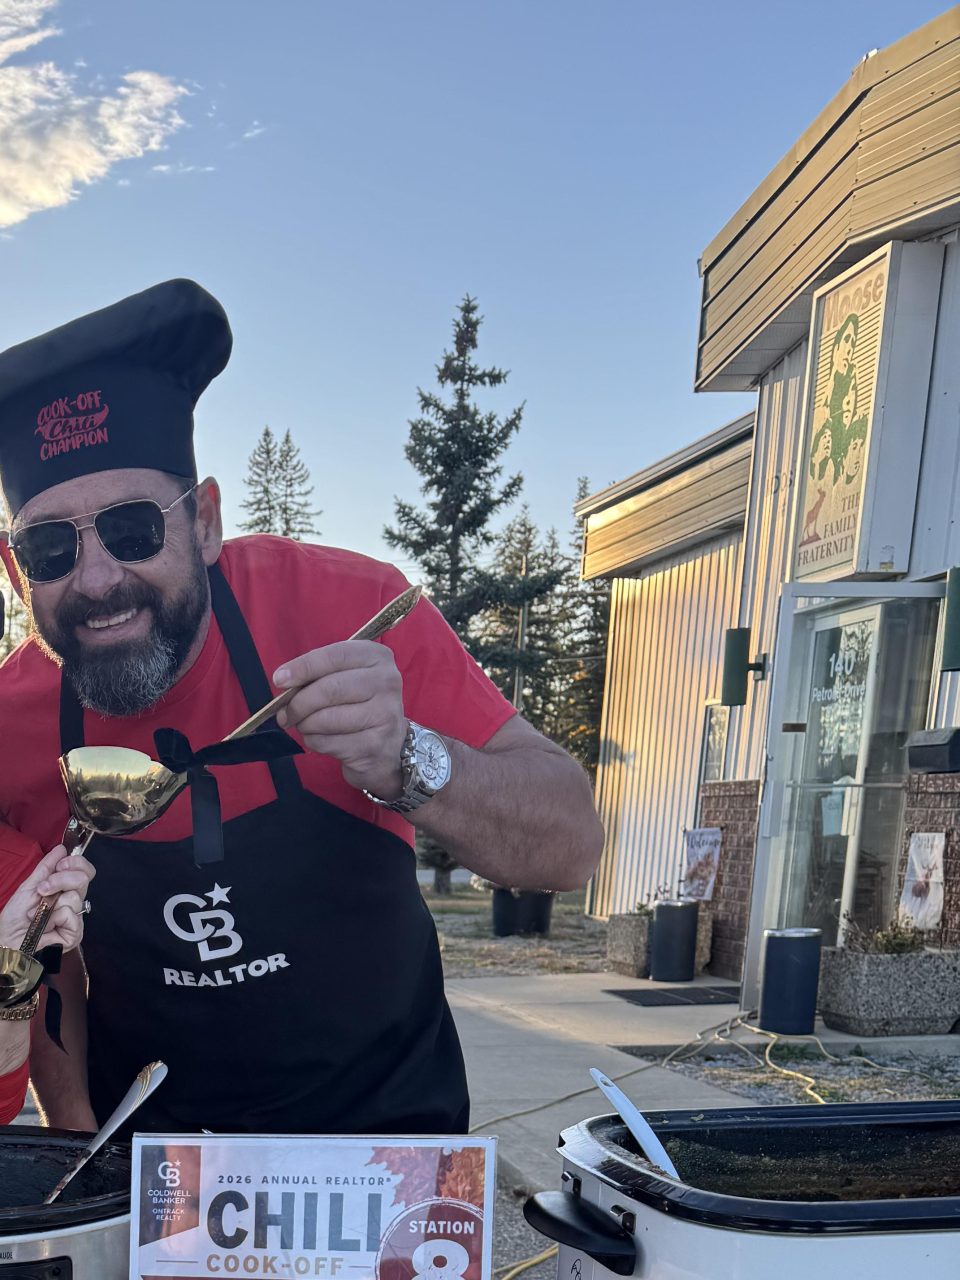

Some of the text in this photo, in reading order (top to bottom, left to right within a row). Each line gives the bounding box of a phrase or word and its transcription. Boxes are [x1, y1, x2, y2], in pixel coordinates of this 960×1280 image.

[825, 273, 885, 332] Moose
[37, 391, 102, 426] COOK-OFF
[40, 428, 108, 460] CHAMPION
[824, 514, 856, 539] FAMILY
[797, 535, 854, 567] FRATERNITY
[829, 652, 855, 678] 140
[163, 953, 291, 987] REALTOR
[147, 1189, 192, 1197] COLDWELL
[218, 1175, 253, 1184] 2026
[261, 1175, 318, 1186] ANNUAL
[152, 1197, 186, 1205] BANKER
[207, 1189, 382, 1252] CHILI
[409, 1220, 475, 1235] STATION
[206, 1253, 344, 1277] COOK-OFF
